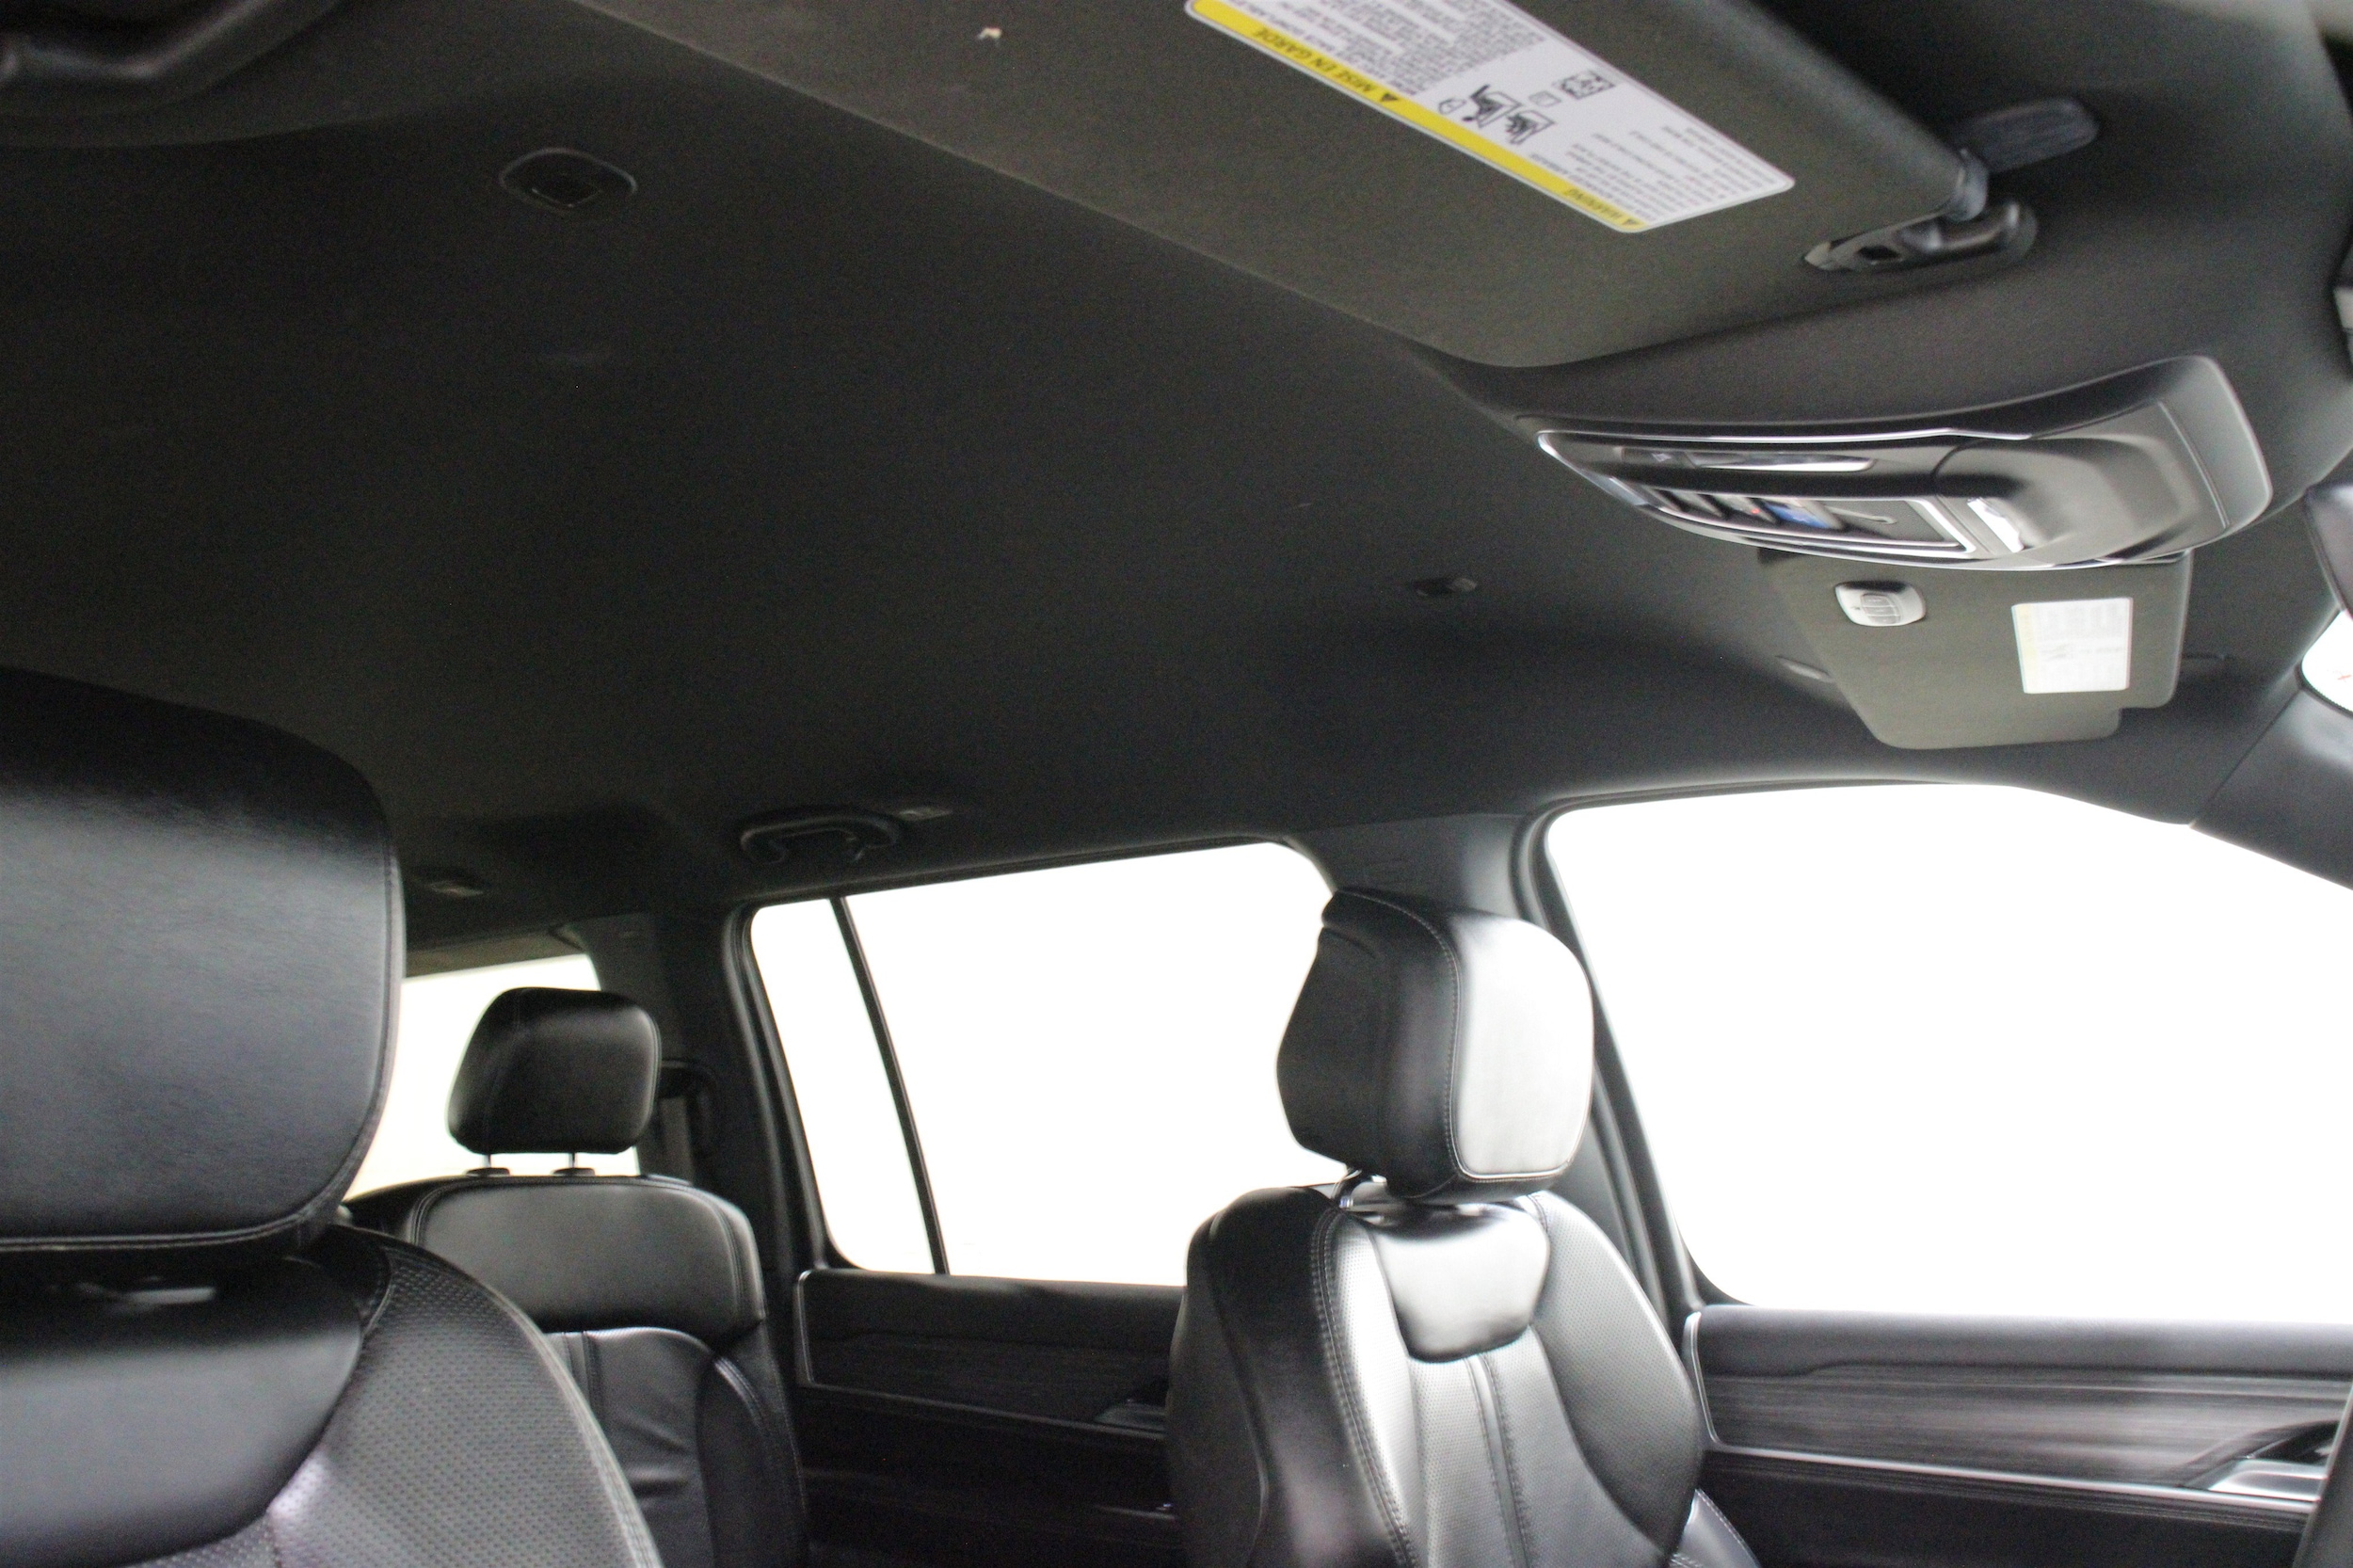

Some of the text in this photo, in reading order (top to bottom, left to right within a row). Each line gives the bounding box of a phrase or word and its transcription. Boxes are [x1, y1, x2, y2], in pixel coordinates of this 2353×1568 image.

[1251, 27, 1377, 92] MISE EN GARDE
